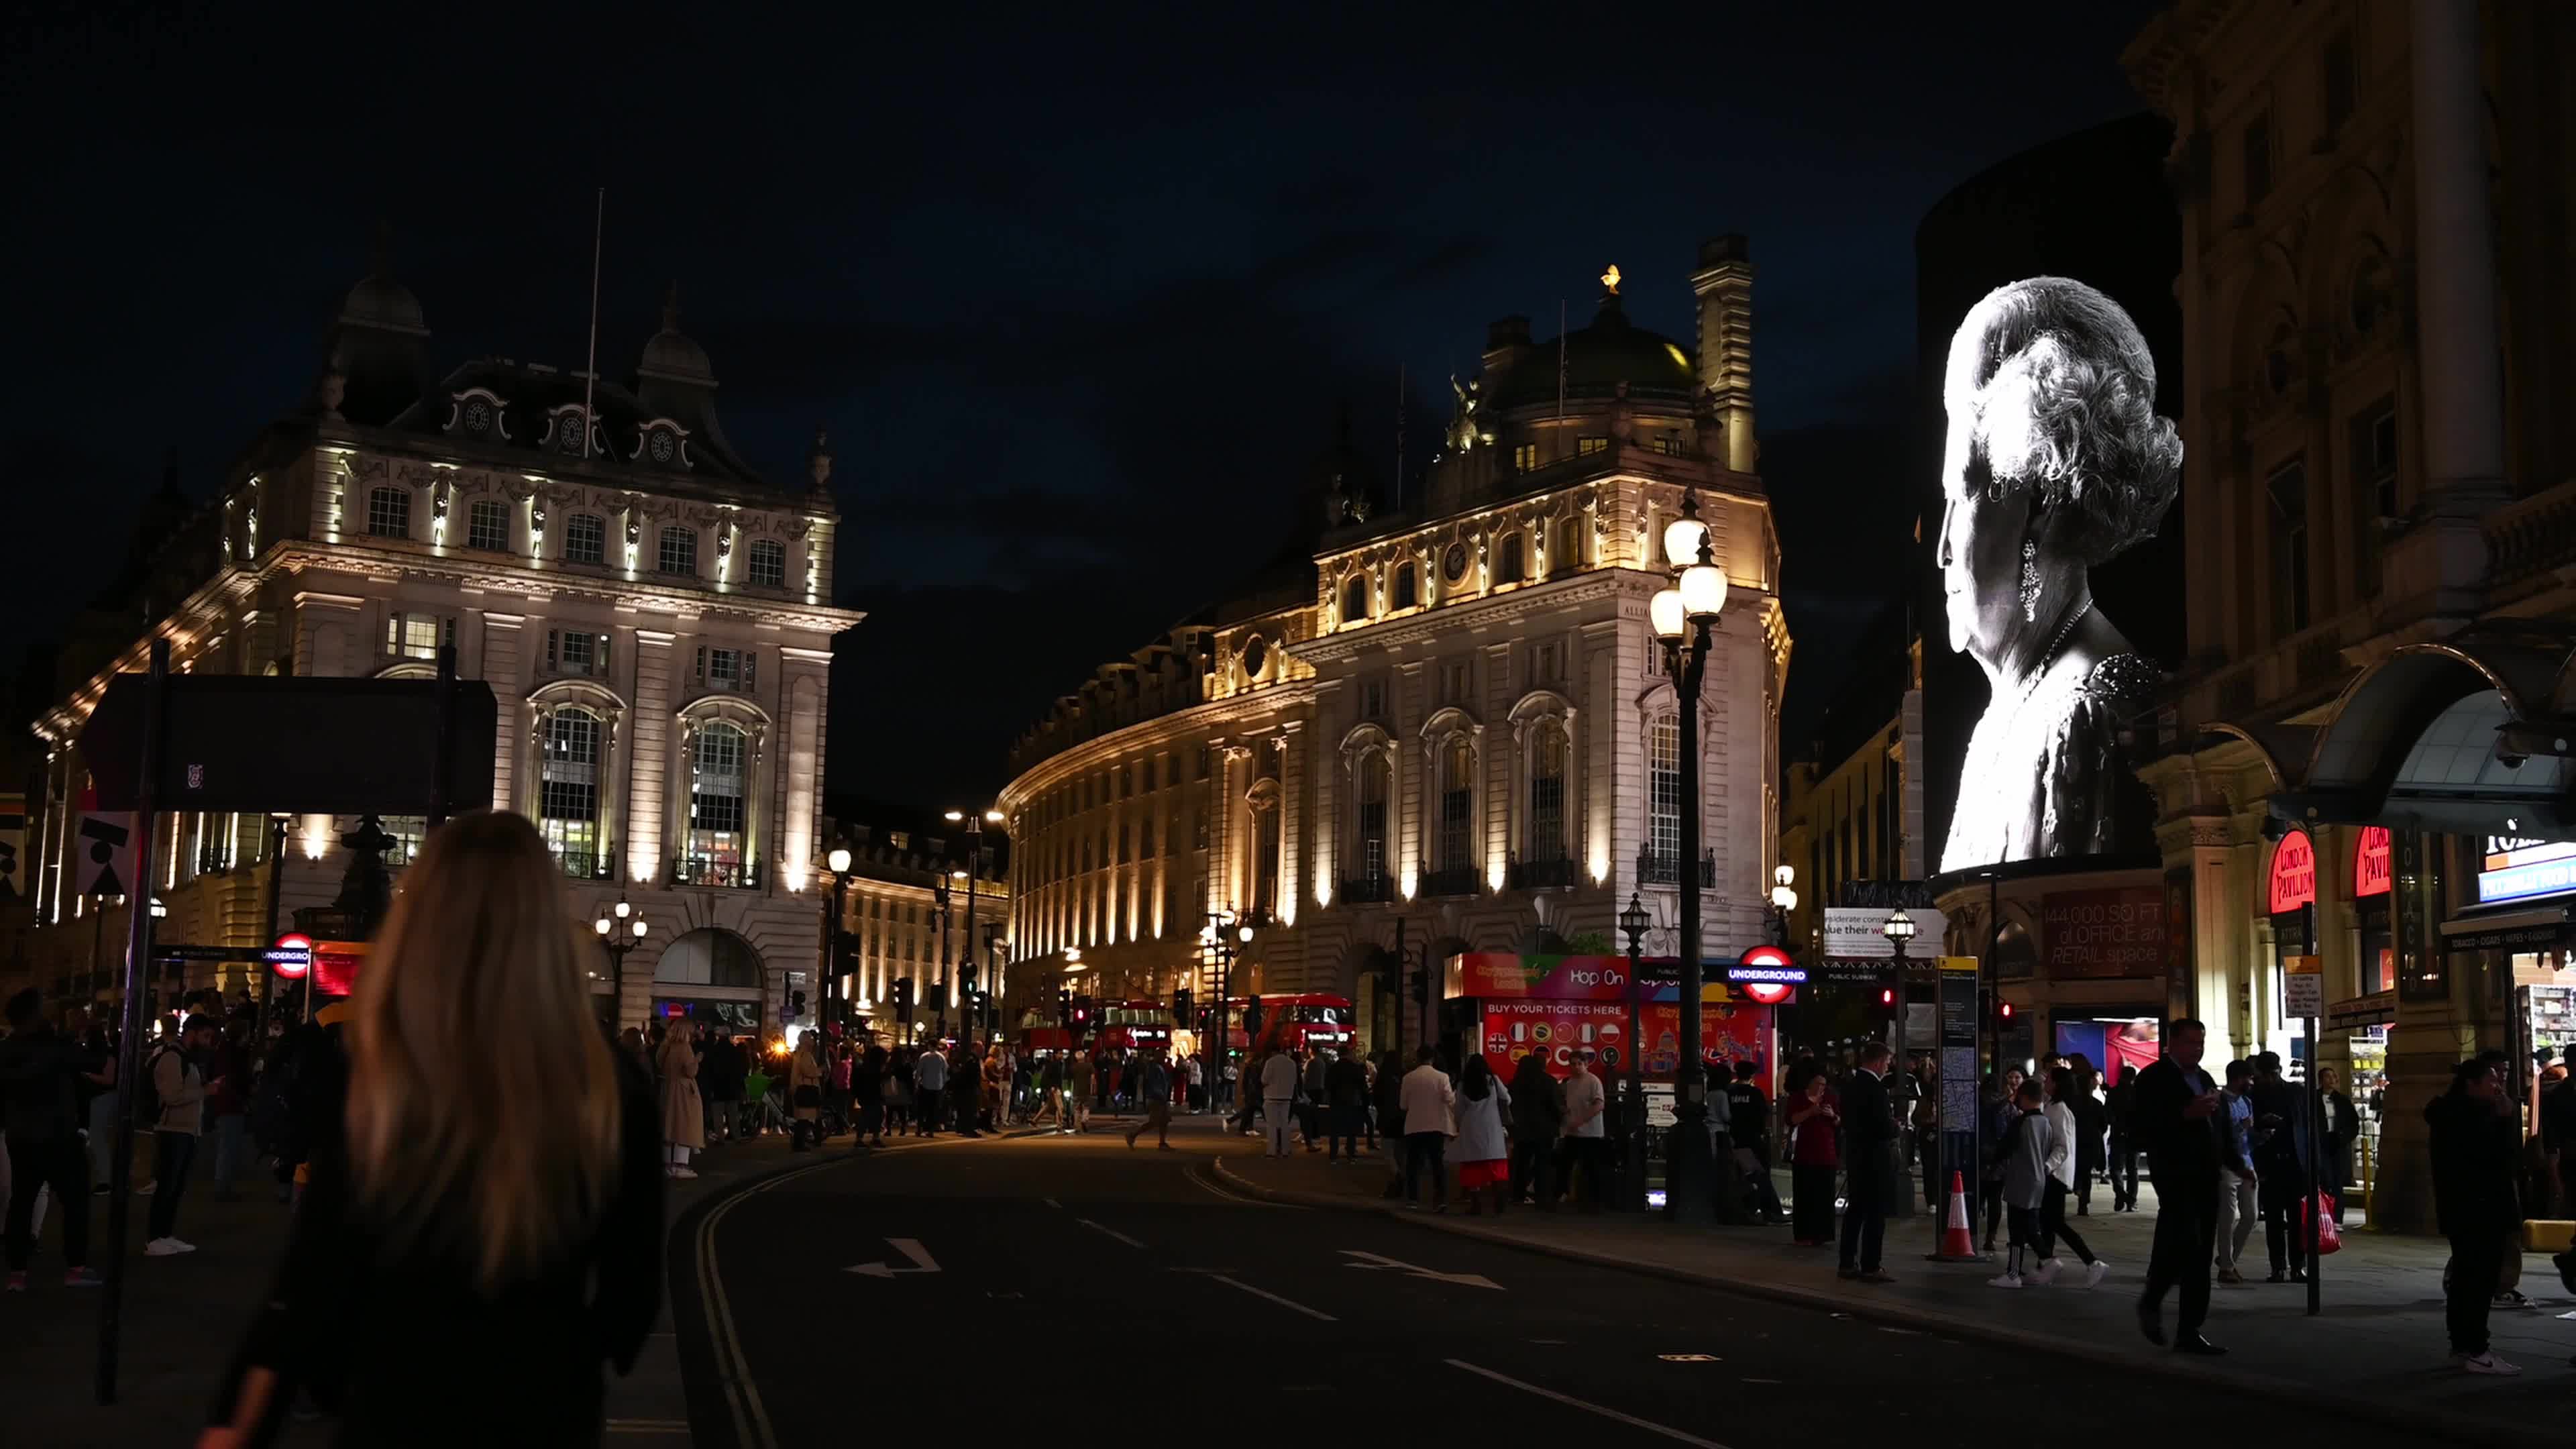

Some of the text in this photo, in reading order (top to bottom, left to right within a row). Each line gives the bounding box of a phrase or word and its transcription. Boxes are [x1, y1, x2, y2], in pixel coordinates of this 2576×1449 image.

[2368, 826, 2389, 850] LOND
[2280, 846, 2308, 871] LONDON
[2363, 852, 2390, 887] PAVIL
[2276, 871, 2314, 906] PAVILION
[2109, 904, 2135, 923] SQ
[1825, 924, 1842, 934] lue
[1845, 924, 1868, 934] their
[2060, 924, 2072, 945] of
[2076, 924, 2137, 944] OFFICE
[261, 951, 308, 961] UNDERGRO
[2051, 946, 2158, 966] RETAIL space
[1570, 969, 1599, 986] Hop
[1604, 969, 1623, 986] On
[1729, 969, 1806, 980] UNDERGROUND
[1488, 1004, 1621, 1015] BUY YOUR TICKETS HERE
